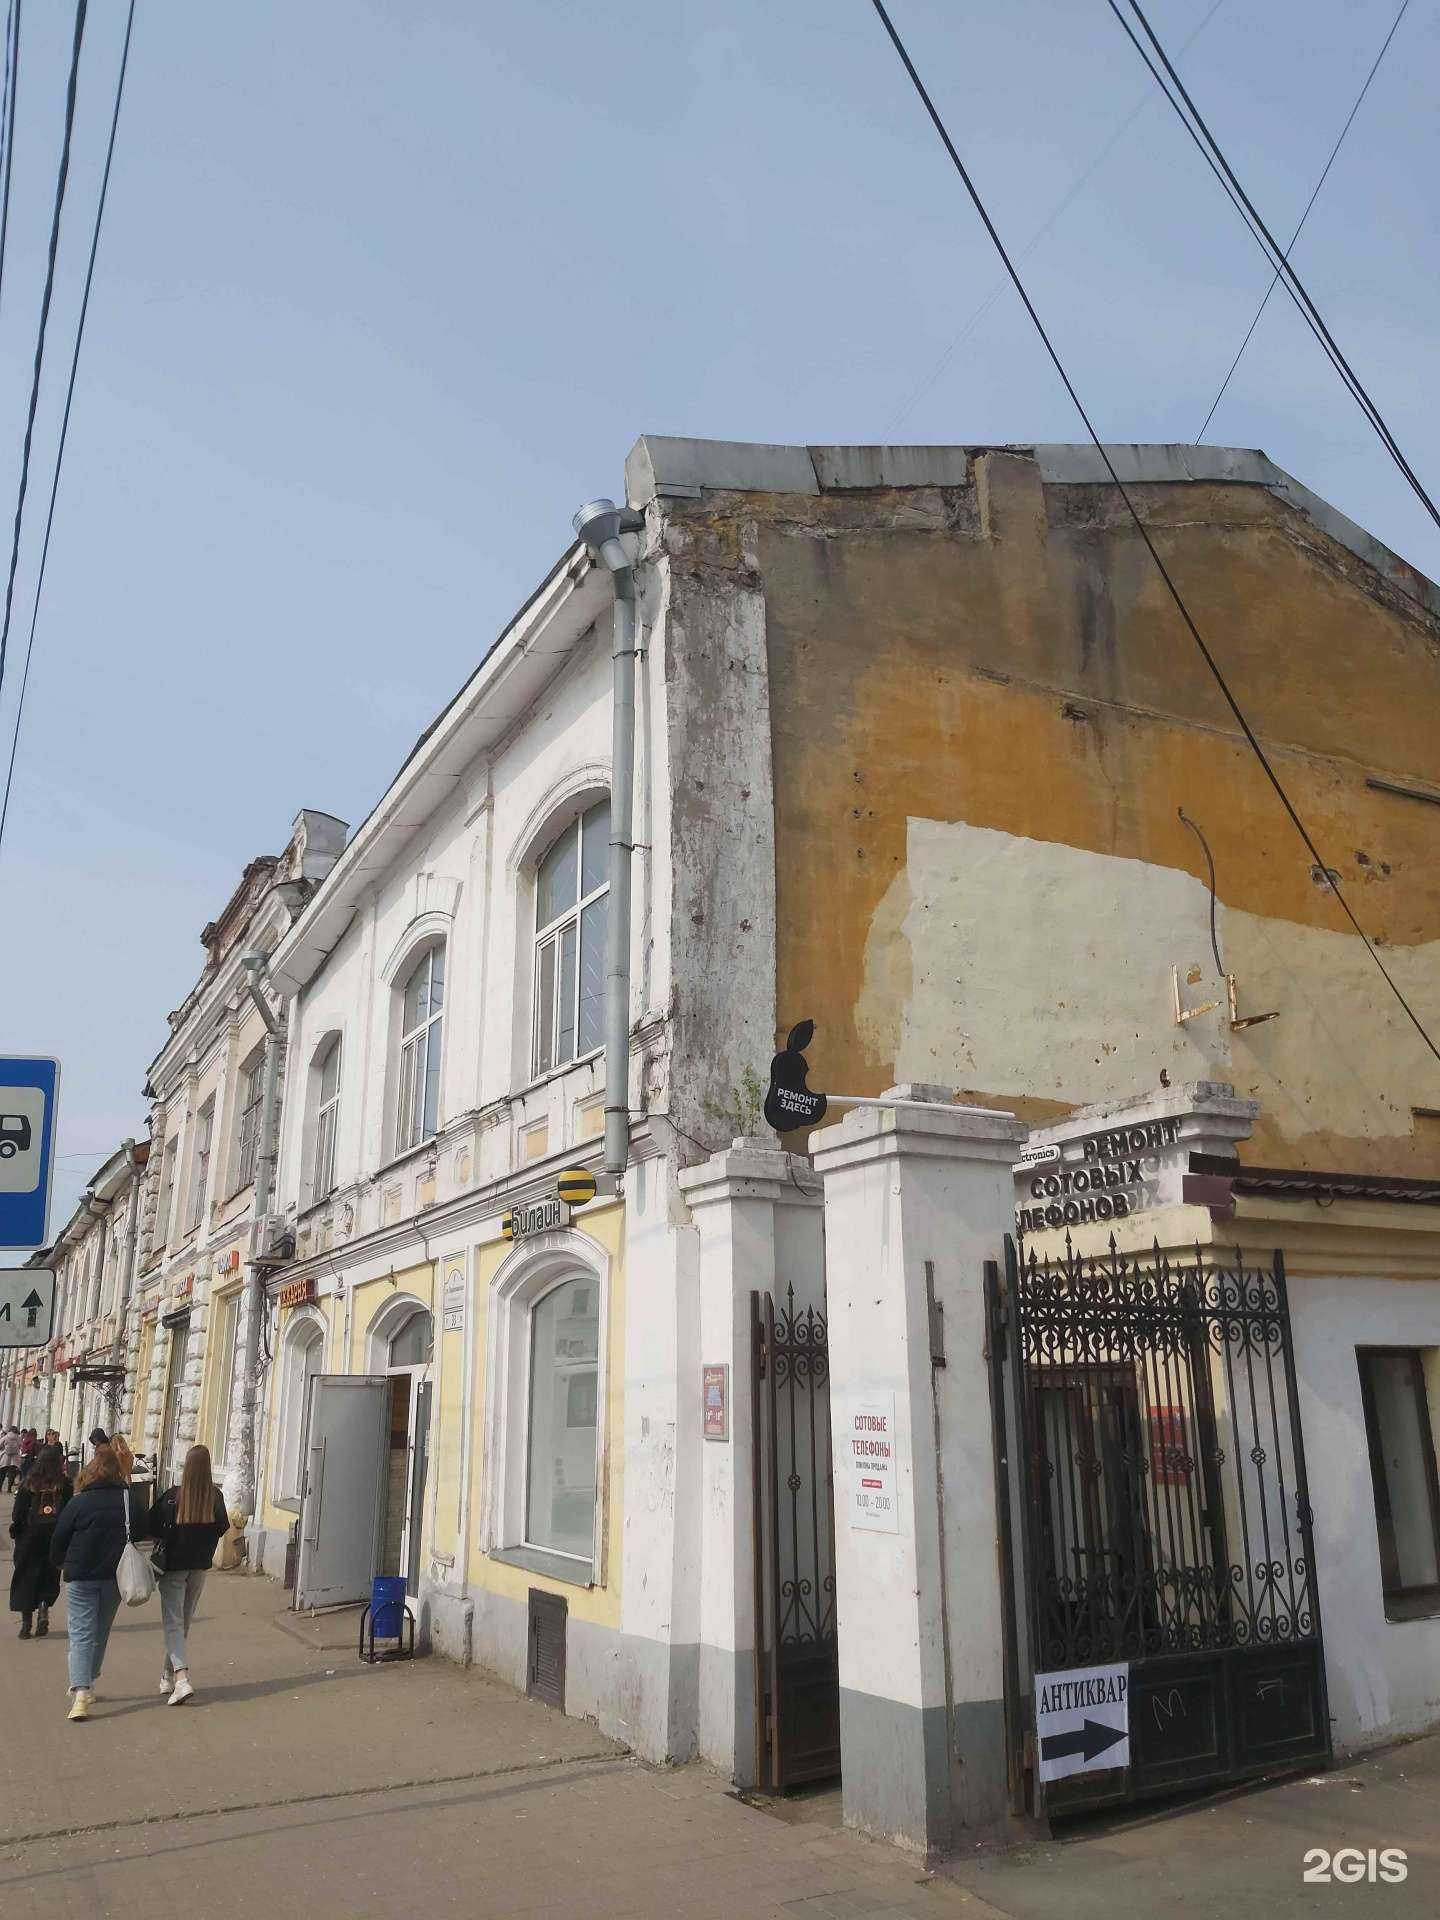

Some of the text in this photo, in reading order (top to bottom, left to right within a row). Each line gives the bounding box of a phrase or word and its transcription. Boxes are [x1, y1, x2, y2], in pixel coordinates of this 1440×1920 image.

[777, 1088, 819, 1107] РЕМОНТ
[780, 1099, 812, 1115] ЗДЕСЬ
[1083, 1118, 1183, 1163] РЕМОНТ
[1030, 1158, 1145, 1200] СОТОВЫХ
[854, 1415, 888, 1432] СОТОВЫЕ
[851, 1439, 891, 1458] ТЕЛЕФОНЫ
[1039, 1675, 1128, 1715] АНТИКВАР
